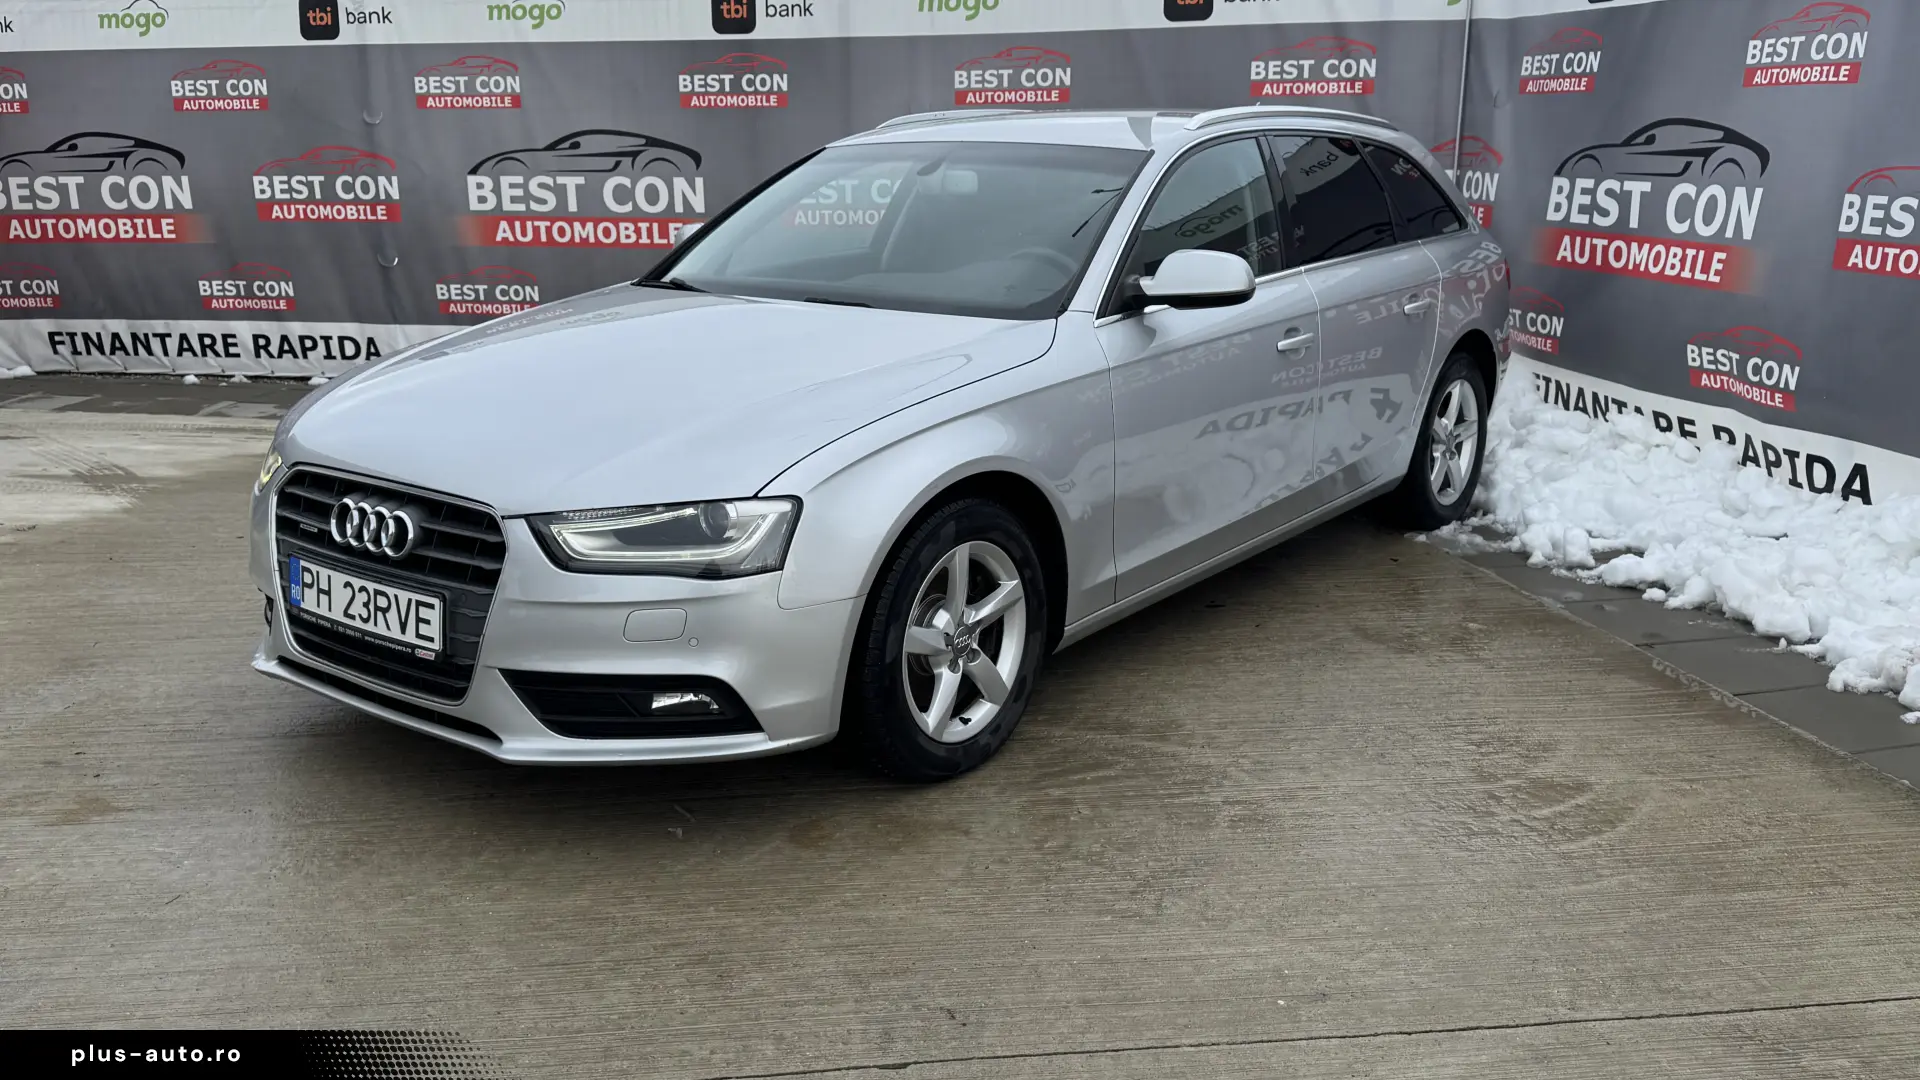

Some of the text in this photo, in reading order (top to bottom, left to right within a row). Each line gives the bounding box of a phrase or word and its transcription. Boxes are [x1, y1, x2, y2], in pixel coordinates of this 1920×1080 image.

[307, 6, 393, 26] tbi bank
[486, 4, 562, 30] mogo
[765, 0, 814, 18] bank
[98, 12, 166, 37] mogo
[1746, 31, 1868, 65] BEST CON
[1250, 58, 1377, 81] BEST CON
[1521, 51, 1602, 76] BEST CON
[414, 75, 521, 94] BEST CON
[678, 73, 789, 93] BEST CON
[954, 67, 1071, 89] BEST CON
[1526, 77, 1588, 93] AUTOMOBILE
[1752, 65, 1850, 85] AUTOMOBILE
[170, 78, 268, 97] BEST CON
[965, 90, 1060, 104] AUTOMOBILE
[1261, 81, 1363, 96] AUTOMOBILE
[182, 99, 260, 112] AUTOMOBILE
[426, 95, 512, 108] AUTOMOBILE
[690, 94, 778, 108] AUTOMOBILE
[100, 174, 193, 211] CON
[252, 174, 400, 200] BEST CON
[466, 174, 706, 215] BEST CON
[1463, 170, 1500, 202] CON
[271, 204, 388, 221] AUTOMOBILE
[1546, 176, 1764, 241] BEST CON
[8, 217, 177, 240] AUTOMOBILE
[495, 219, 683, 246] AUTOMOBILE
[1556, 234, 1727, 284] AUTOMOBILE
[19, 279, 60, 296] CON
[198, 280, 294, 298] BEST CON
[435, 284, 540, 302] BEST CON
[211, 298, 287, 310] AUTOMOBILE
[1526, 311, 1564, 338] CON
[47, 331, 383, 362] FINANTARE RAPIDA
[1686, 343, 1800, 391] BEST CON
[1700, 372, 1784, 408] AUTOMOBILE
[291, 583, 300, 600] RO
[301, 564, 435, 643] PH 23RVE
